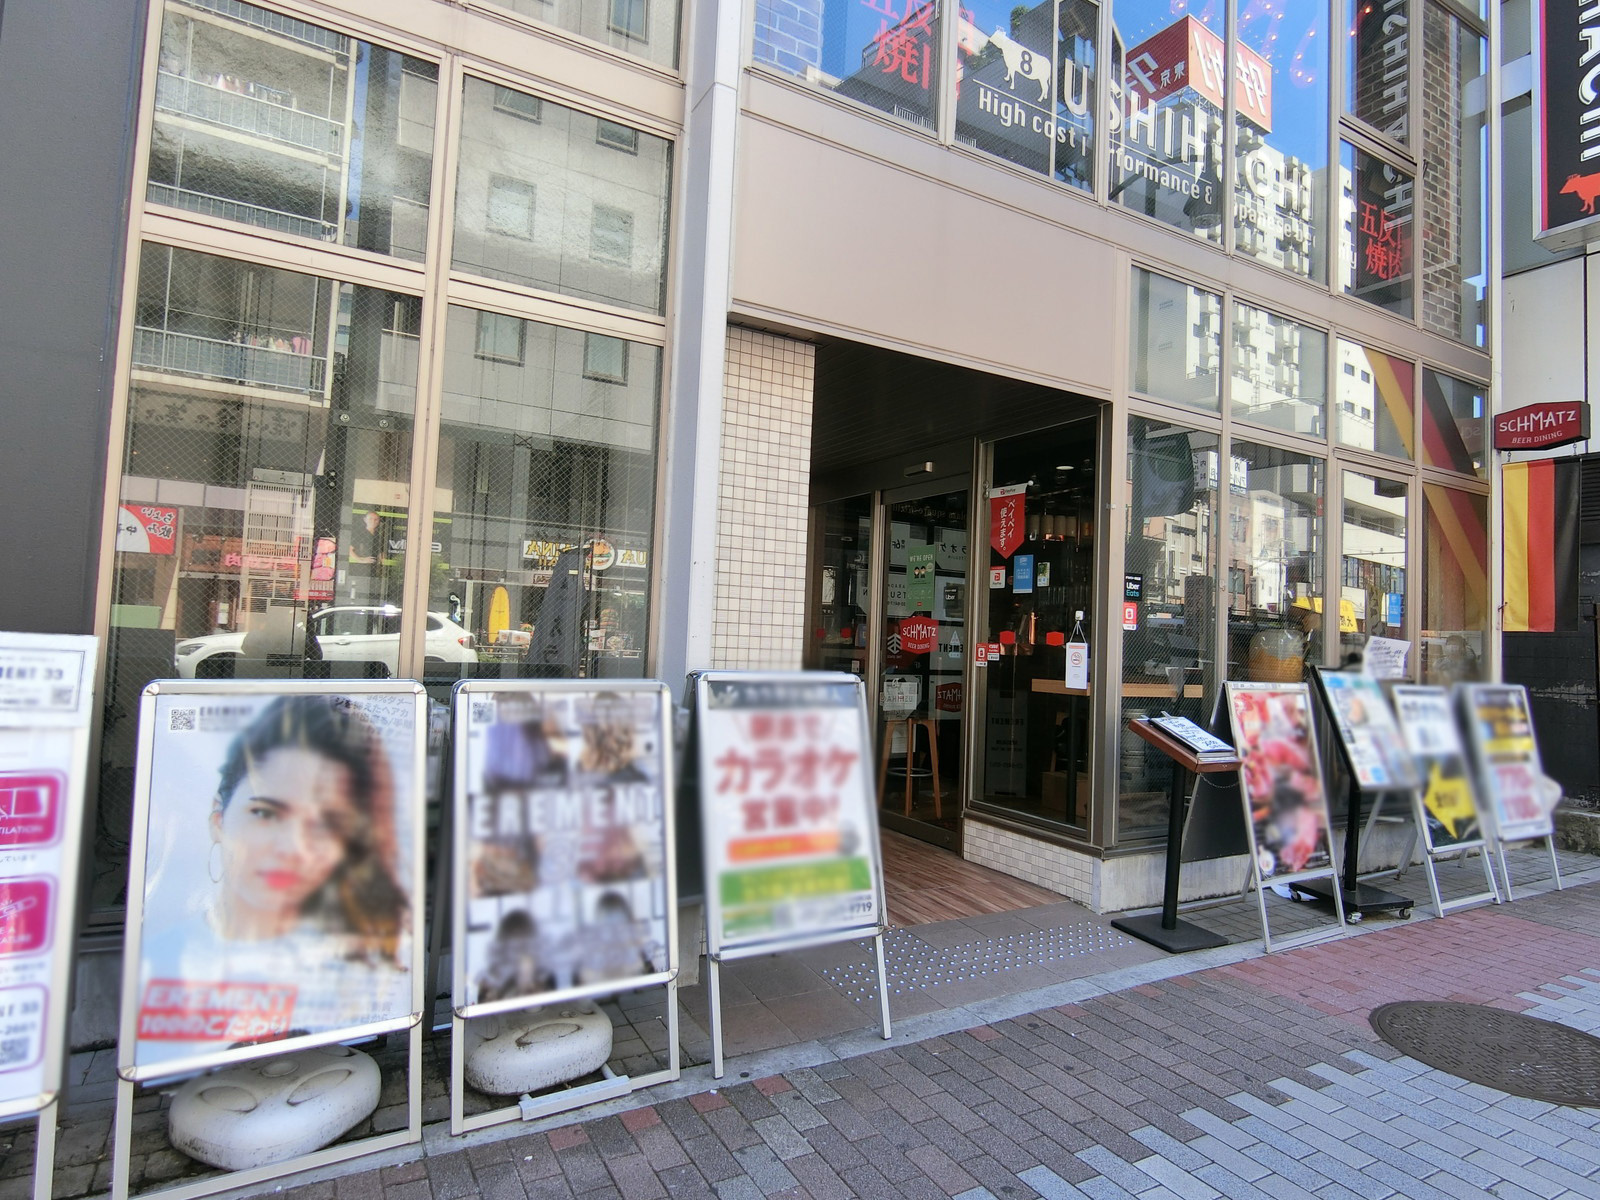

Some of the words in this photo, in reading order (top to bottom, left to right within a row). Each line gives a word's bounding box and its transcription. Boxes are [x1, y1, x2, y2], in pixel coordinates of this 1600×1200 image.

[978, 87, 1027, 128] High
[1032, 115, 1076, 149] cost
[1499, 410, 1577, 433] SCHMATZ
[1511, 436, 1532, 444] BEER
[1533, 430, 1563, 443] DINING
[1007, 499, 1016, 539] ペイペイ
[1126, 581, 1140, 590] Uber
[902, 623, 937, 640] SCHMATZ
[714, 745, 859, 795] カラオケ
